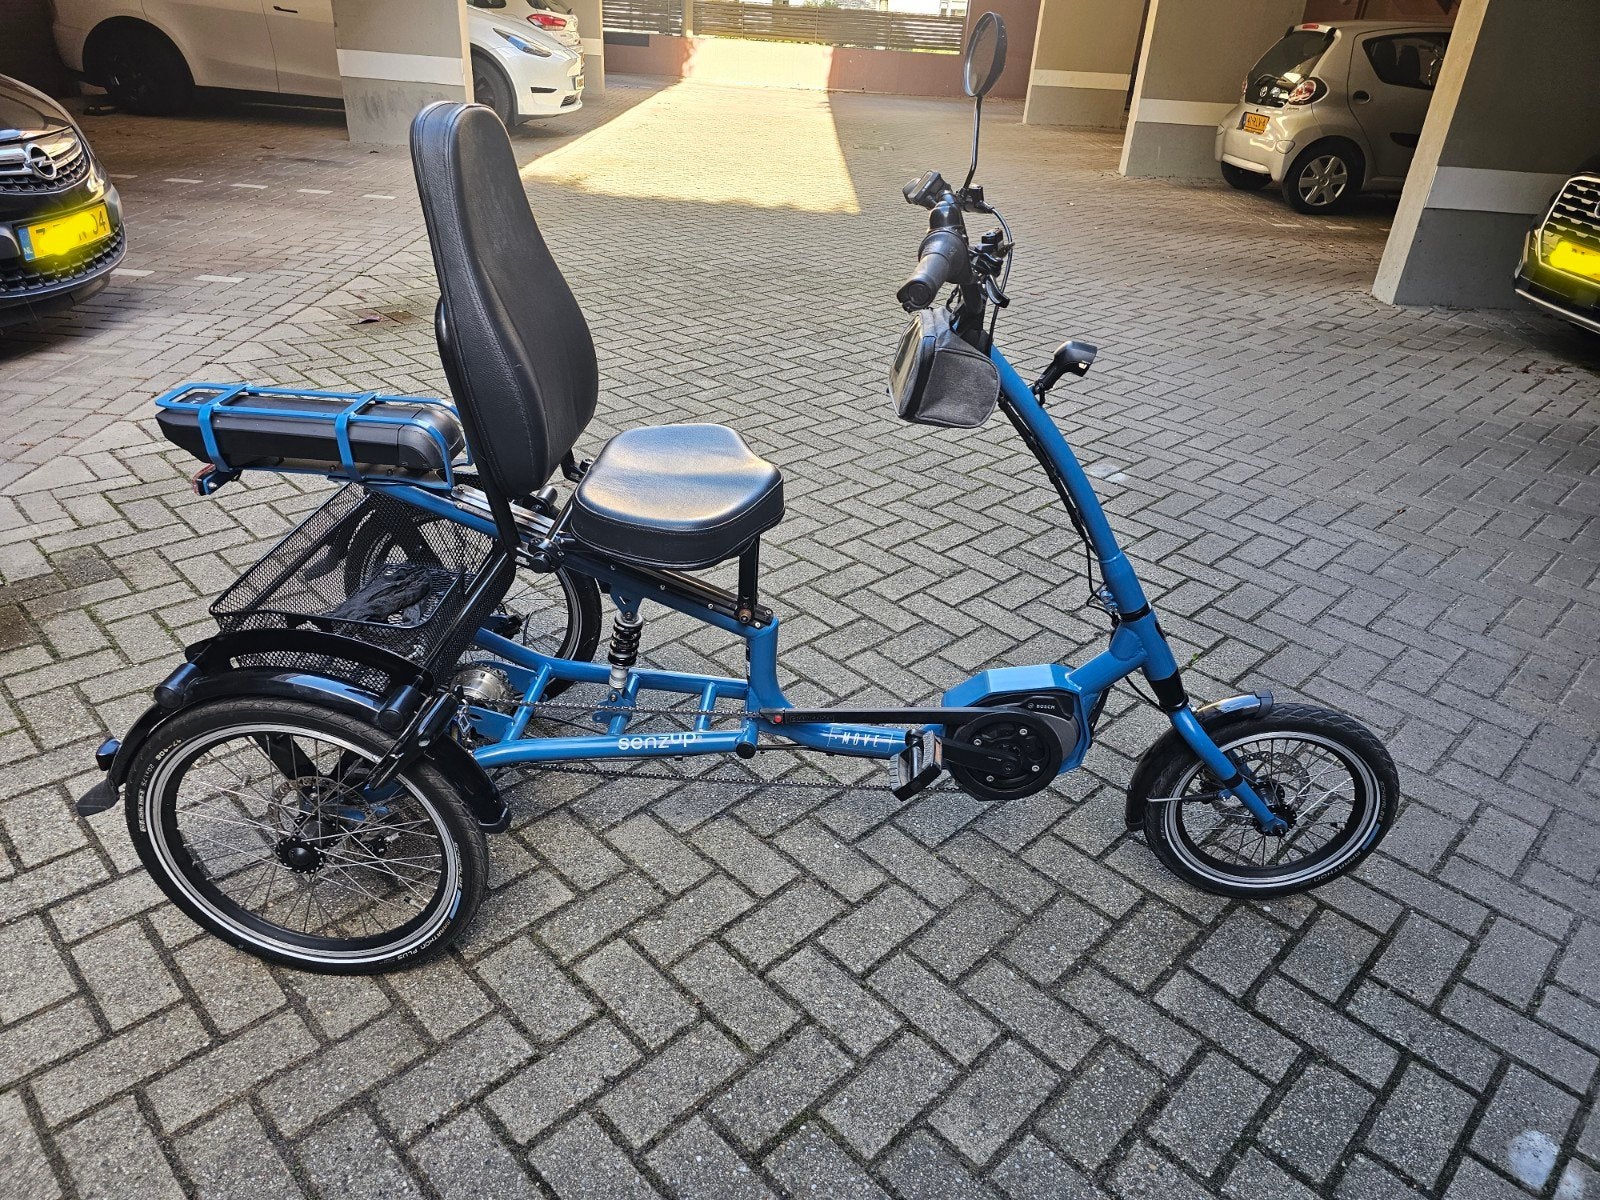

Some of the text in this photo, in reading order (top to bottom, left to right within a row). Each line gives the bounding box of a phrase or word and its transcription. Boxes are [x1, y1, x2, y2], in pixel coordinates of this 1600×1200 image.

[617, 731, 697, 750] senzup
[396, 918, 452, 961] MARATHON PLUS
